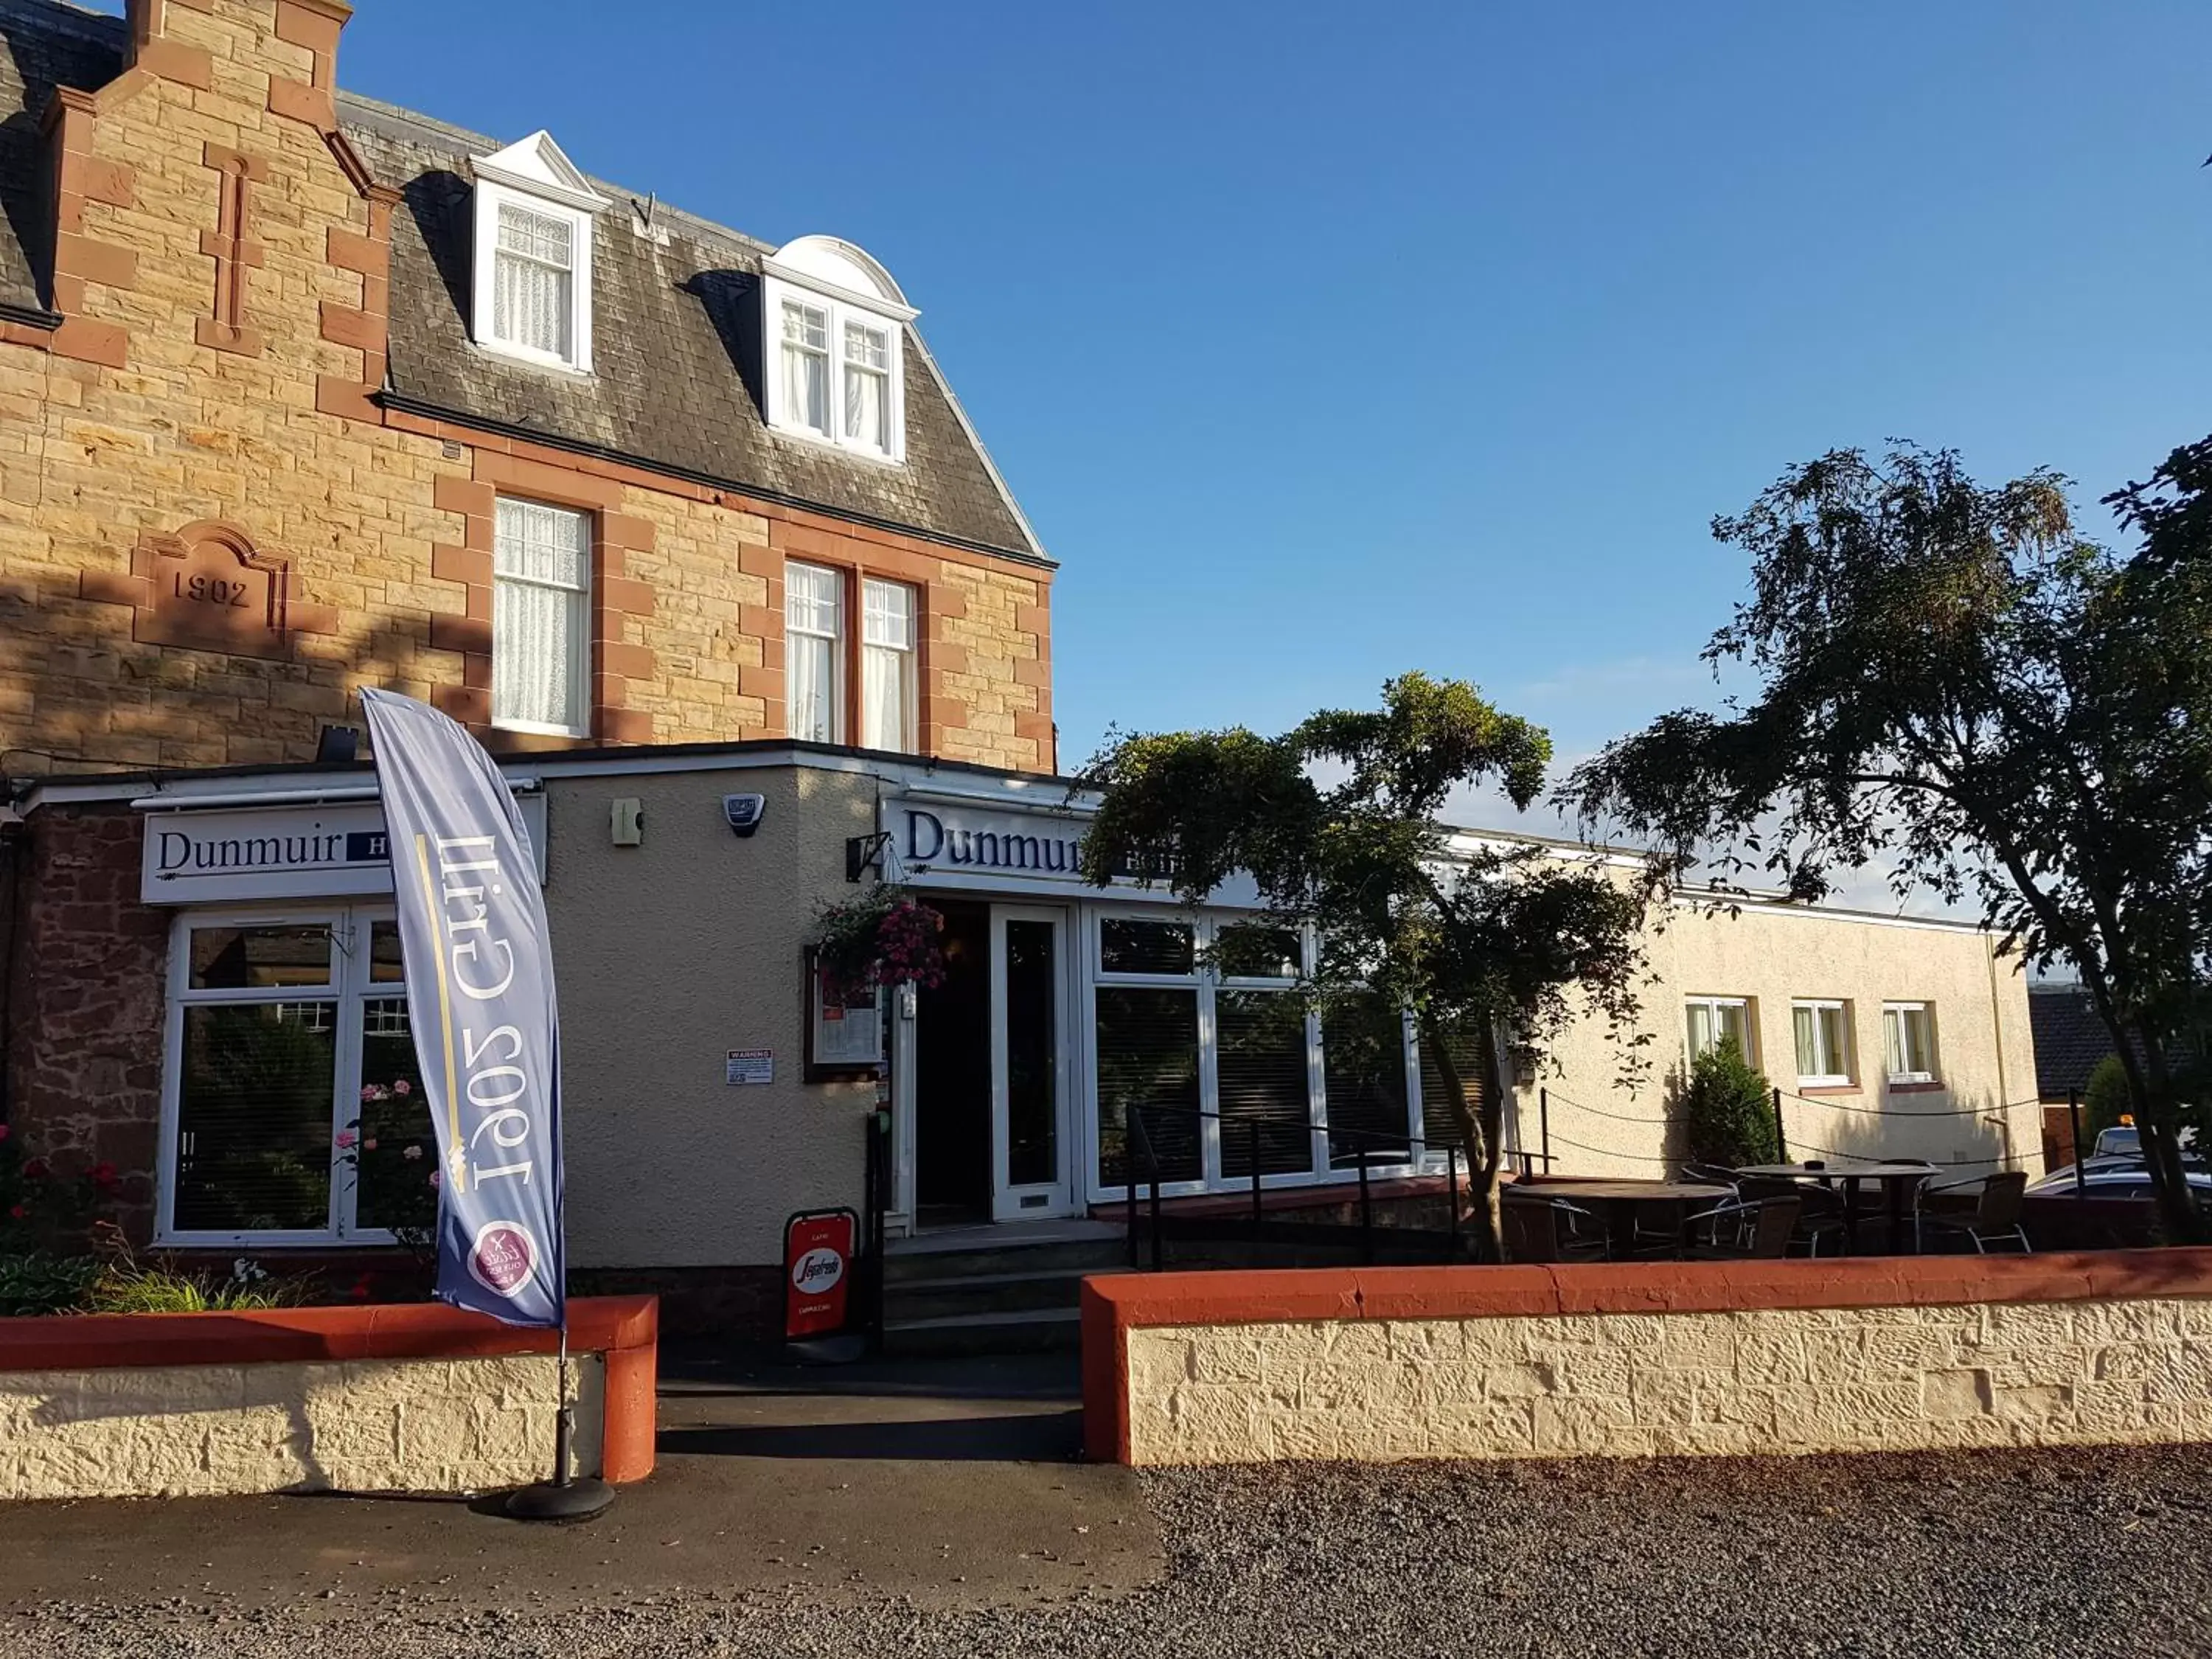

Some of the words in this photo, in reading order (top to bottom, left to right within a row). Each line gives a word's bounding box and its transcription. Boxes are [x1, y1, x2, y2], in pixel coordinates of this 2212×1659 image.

[174, 571, 251, 608] 1902
[156, 821, 344, 871] Dunmuir
[903, 809, 1081, 873] Dunmui
